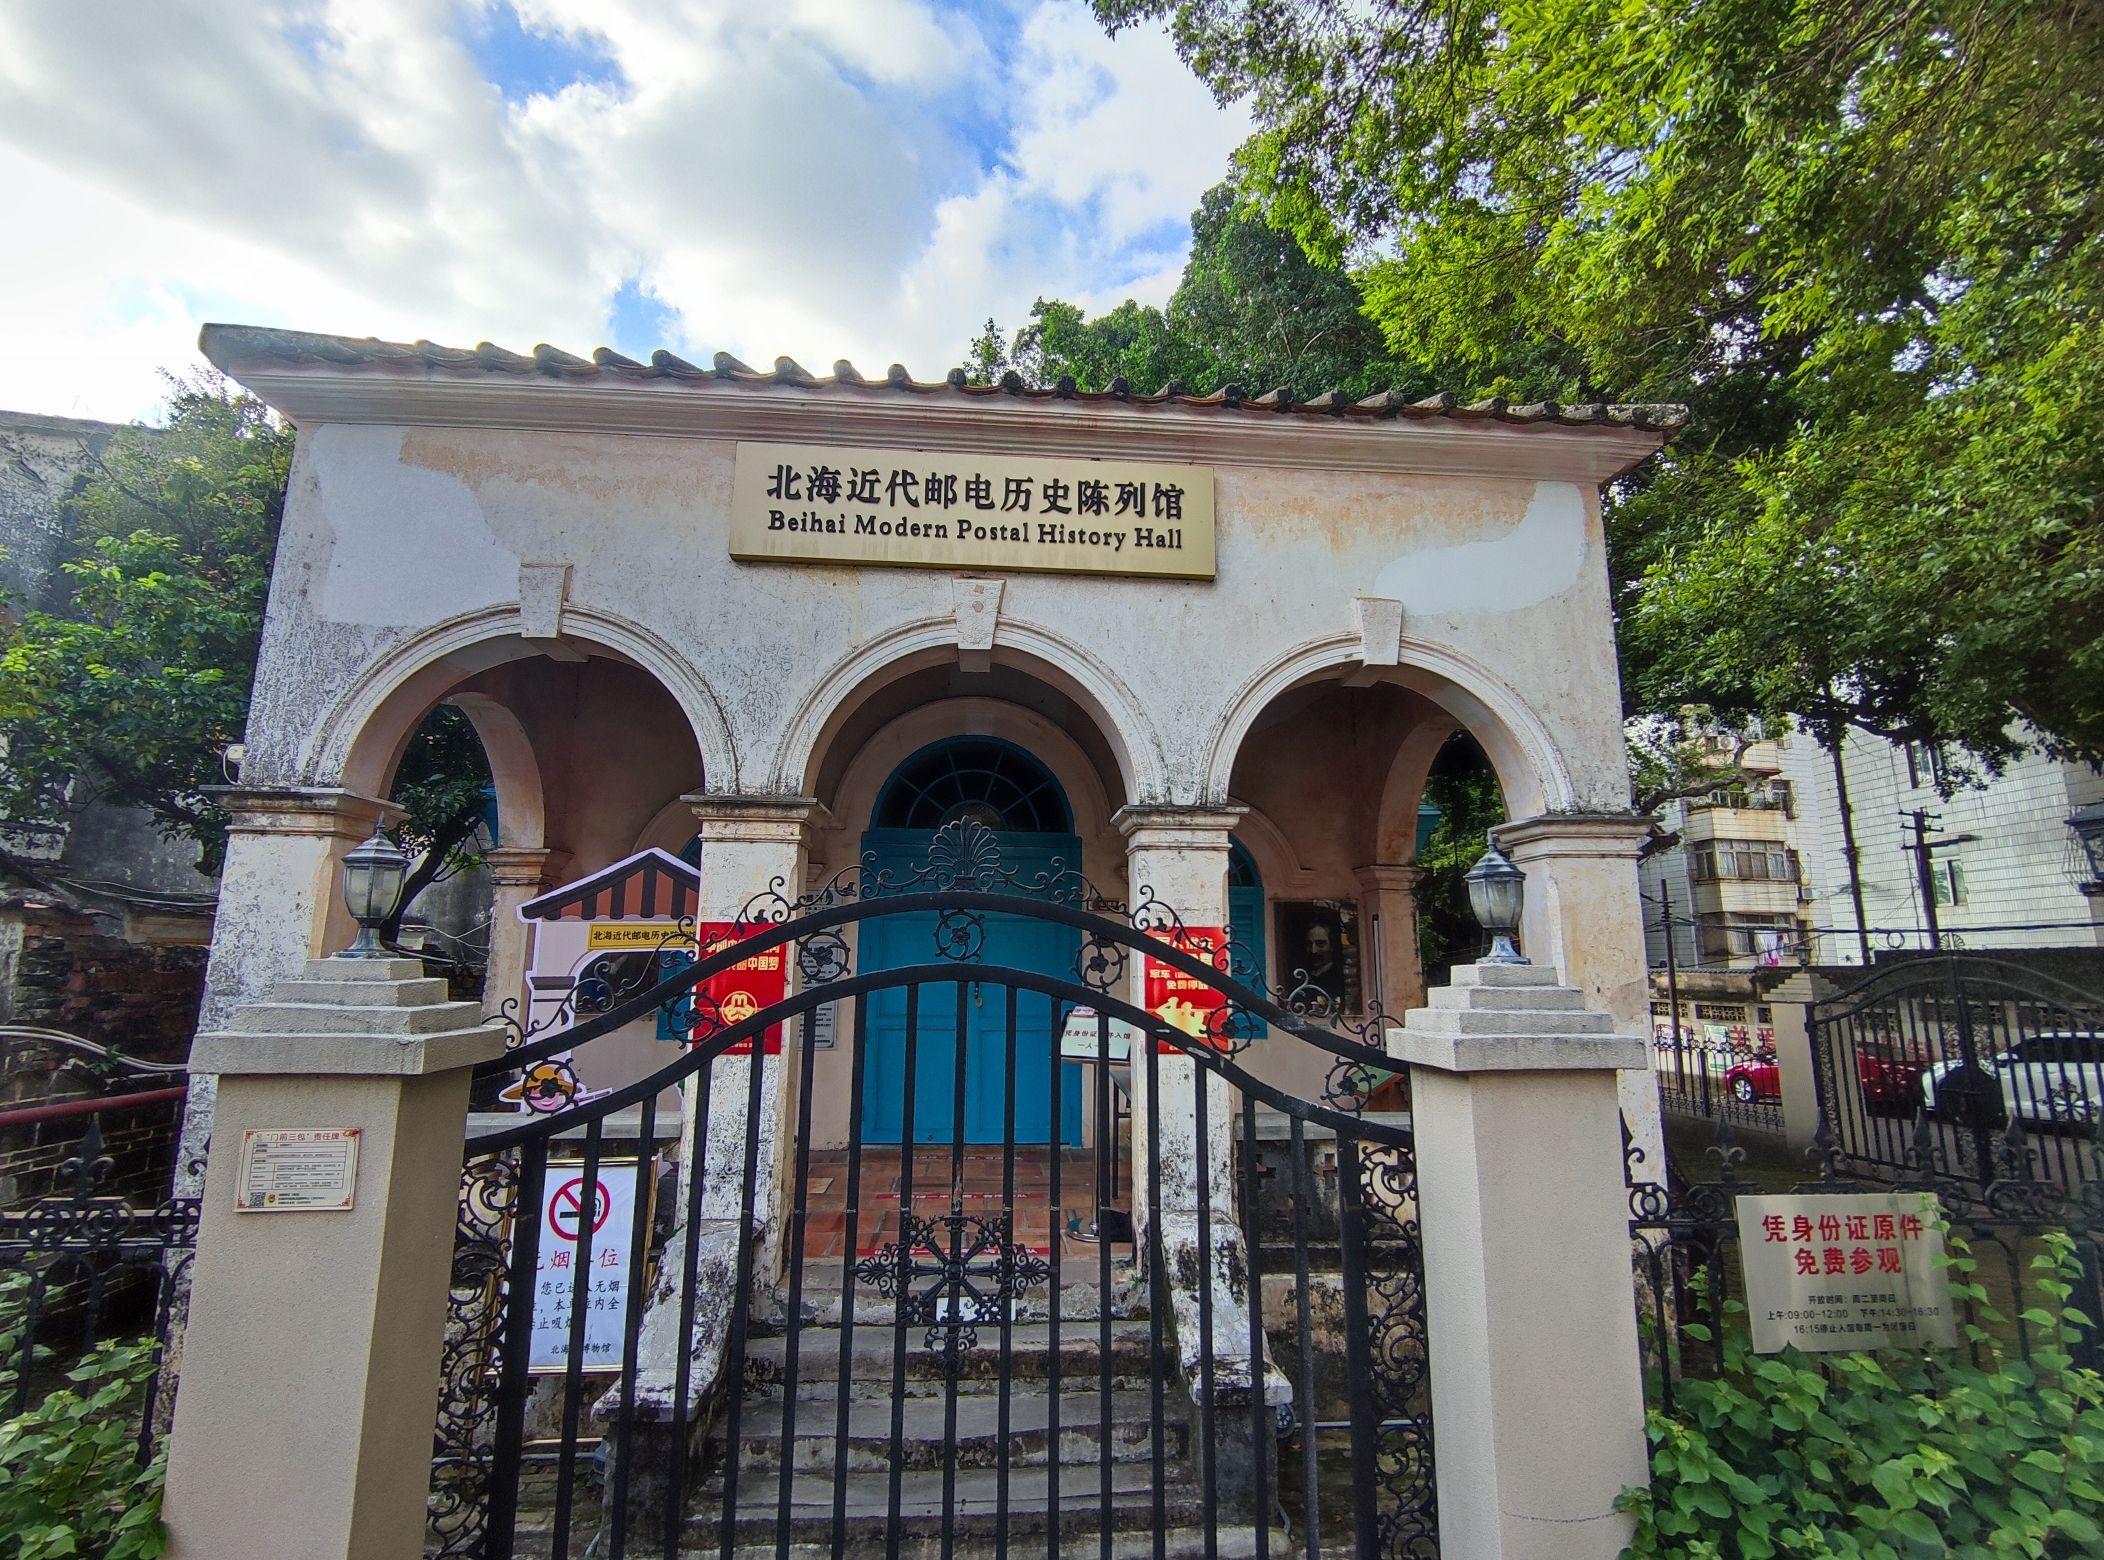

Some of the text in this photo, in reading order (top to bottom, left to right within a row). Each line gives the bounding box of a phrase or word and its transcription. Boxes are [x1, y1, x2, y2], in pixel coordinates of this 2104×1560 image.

[766, 464, 1185, 520] 北海近代邮电历史陈列馆
[767, 510, 1183, 551] Beihai Modern Postal History Hall
[1762, 1214, 1924, 1242] 凭身份证原件
[1794, 1246, 1902, 1276] 免费参观
